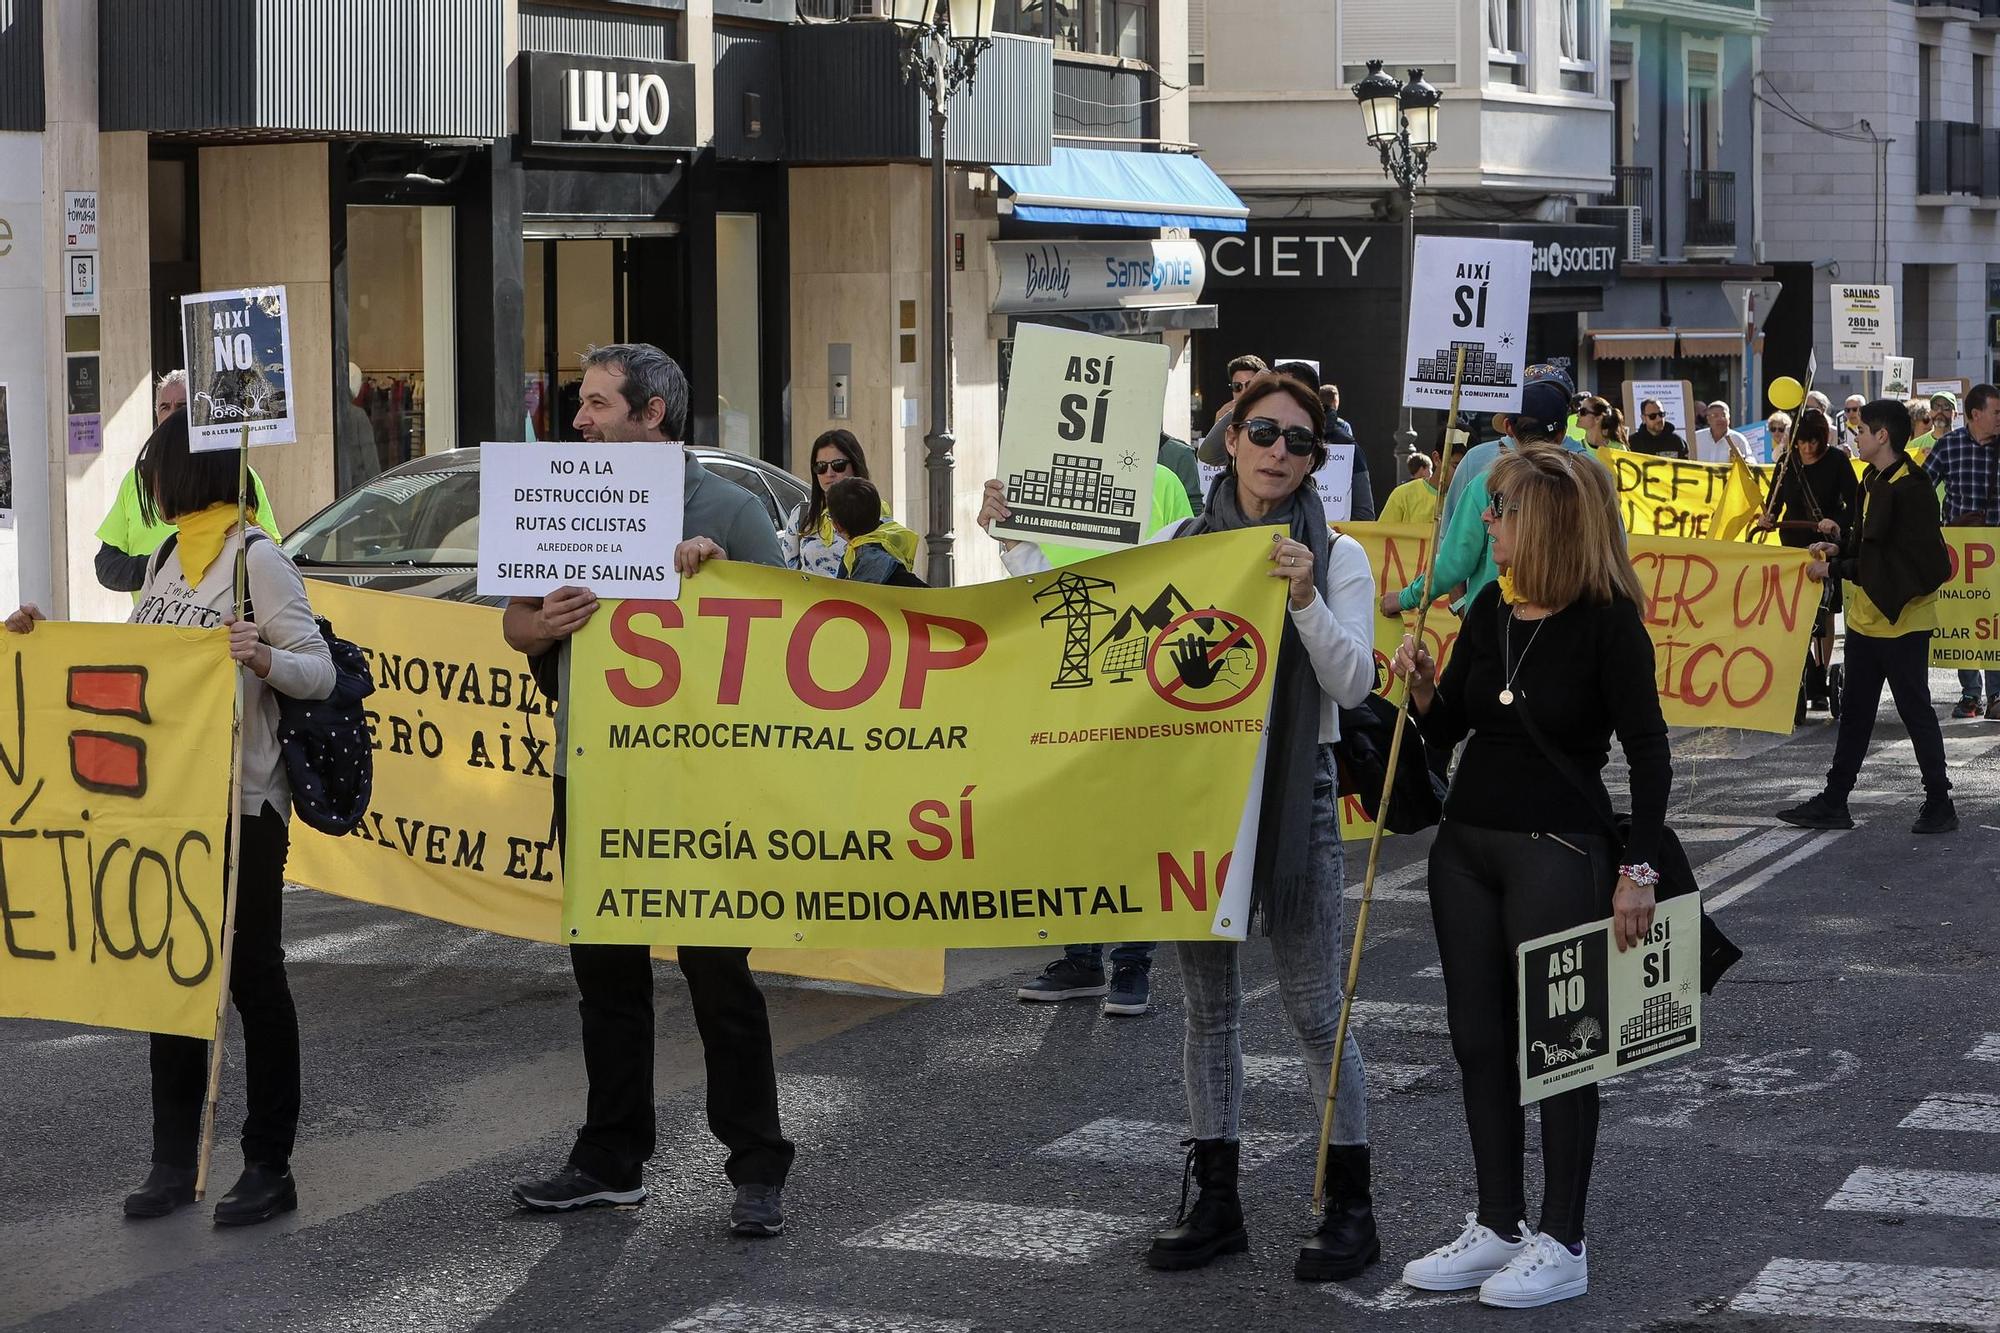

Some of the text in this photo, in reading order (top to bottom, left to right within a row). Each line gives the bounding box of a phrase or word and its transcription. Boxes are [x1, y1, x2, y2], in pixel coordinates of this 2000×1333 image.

[67, 208, 96, 222] tomasa
[77, 263, 87, 275] CS
[1201, 236, 1372, 277] CIETY
[1563, 246, 1616, 272] SOCIETY
[78, 276, 88, 288] 15
[1106, 256, 1192, 291] Samsonite
[1456, 261, 1491, 280] AIXÍ
[1452, 281, 1490, 328] SÍ
[1843, 288, 1880, 299] SALINAS
[213, 305, 251, 331] AIXÍ
[1848, 316, 1880, 328] 280 ha
[213, 333, 253, 373] NO
[1064, 356, 1115, 386] ASÍ
[1415, 386, 1423, 394] SÍ
[1464, 390, 1510, 399] COMUNITARIA
[229, 424, 278, 435] MACOPLANTES
[1057, 389, 1113, 444] SÍ
[550, 460, 614, 475] NO A LA
[514, 485, 650, 504] DESTRUCCIÓN DE
[515, 516, 647, 532] RUTAS CICLISTAS
[1015, 514, 1121, 536] SÍ A LA ENERGÍA COMUNITARIA
[536, 542, 623, 553] ALREDEDOR DE LA
[497, 563, 666, 582] SIERRA DE SALINAS
[1938, 587, 1991, 600] INALOPÓ
[1975, 613, 2000, 640] SÍ
[604, 597, 989, 711] STOP
[608, 723, 969, 752] MACROCENTRAL SOLAR
[1029, 718, 1264, 745] #ELDADEFIENDESUSMONTES
[600, 785, 978, 862] ENERGÍA SOLAR SÍ
[596, 850, 1234, 921] ATENTADO MEDIOAMBIENTAL N
[1643, 916, 1671, 947] ASÍ
[1548, 940, 1584, 979] ASÍ
[1643, 941, 1671, 989] SÍ
[1548, 975, 1585, 1019] NO
[1561, 1063, 1595, 1079] MACROPLANTAS
